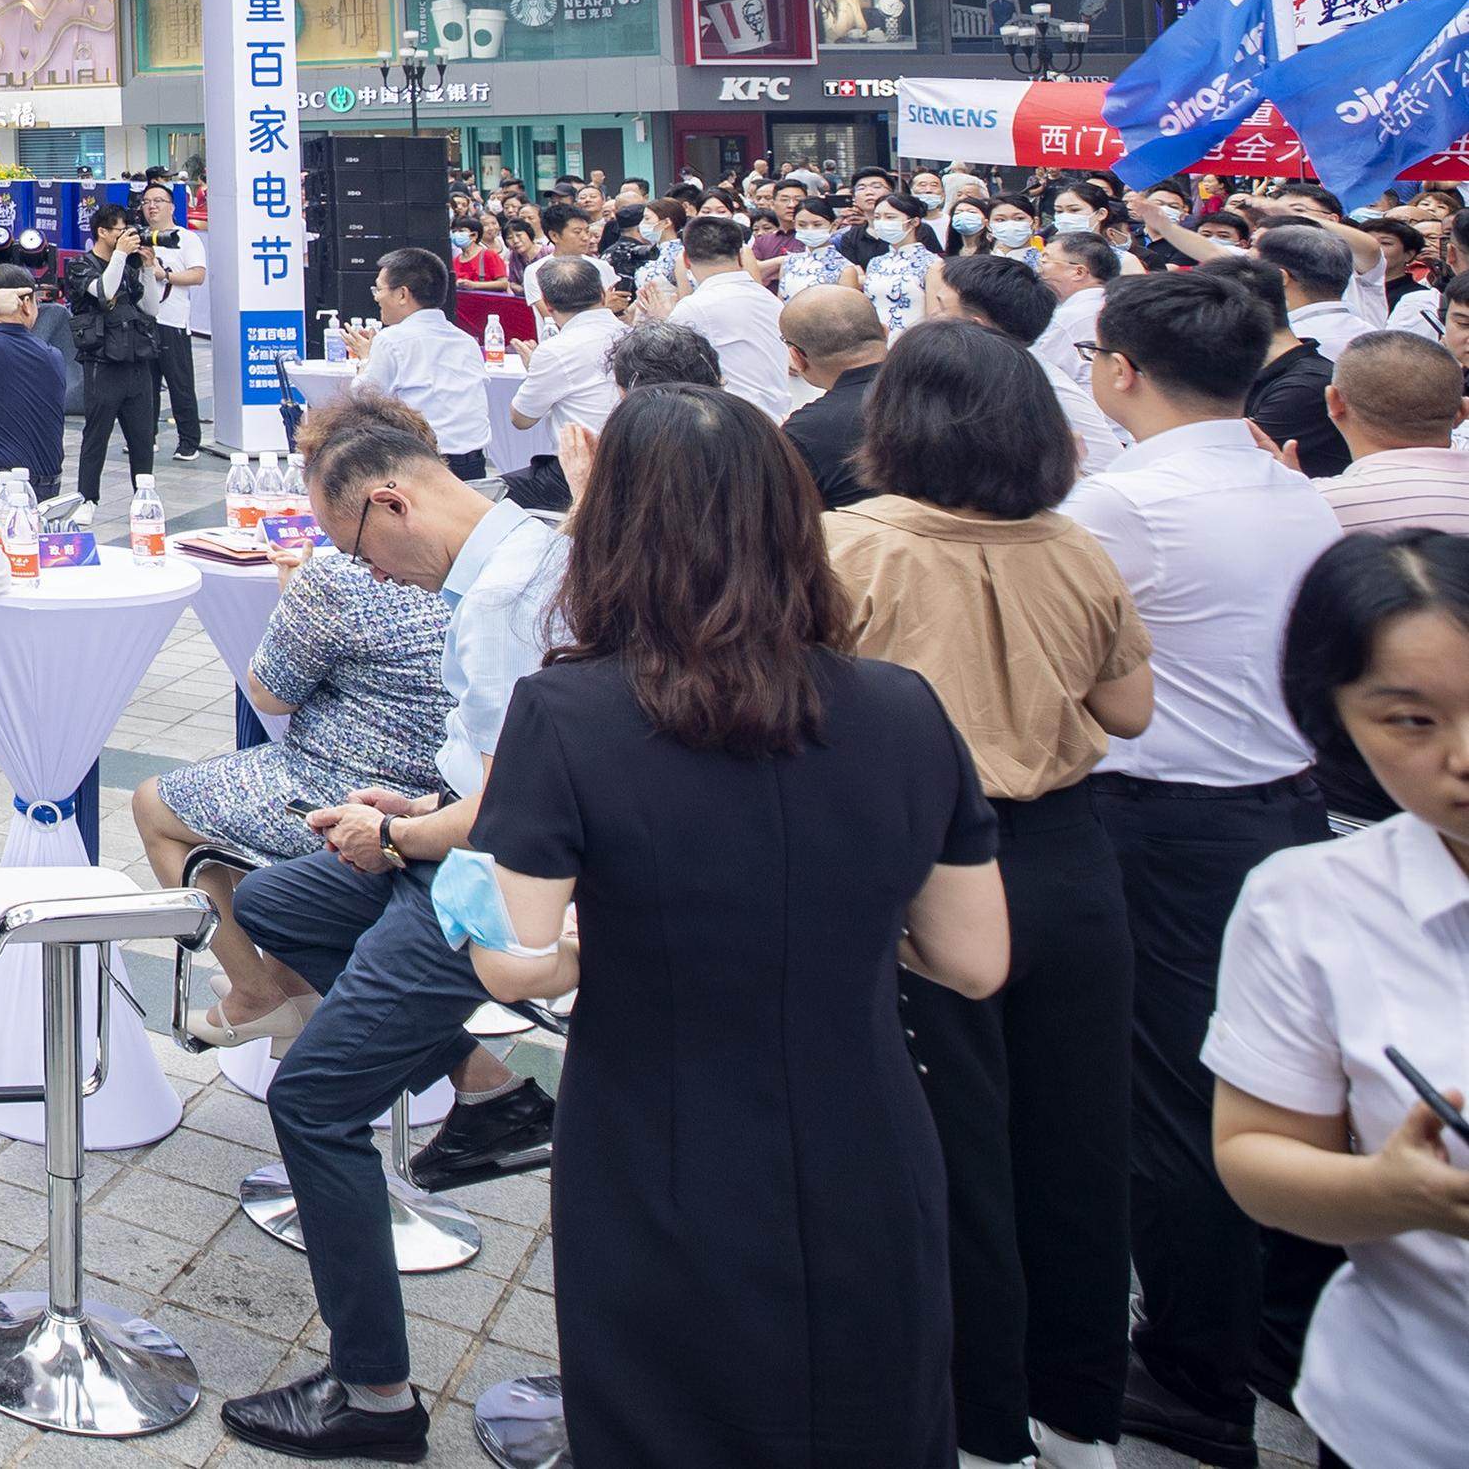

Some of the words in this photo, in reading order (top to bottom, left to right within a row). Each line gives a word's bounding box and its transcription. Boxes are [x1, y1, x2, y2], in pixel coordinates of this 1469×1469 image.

[358, 81, 491, 105] 中国农业银行
[718, 76, 791, 101] KFC
[908, 104, 998, 129] SIEMENS
[49, 544, 75, 557] 政府
